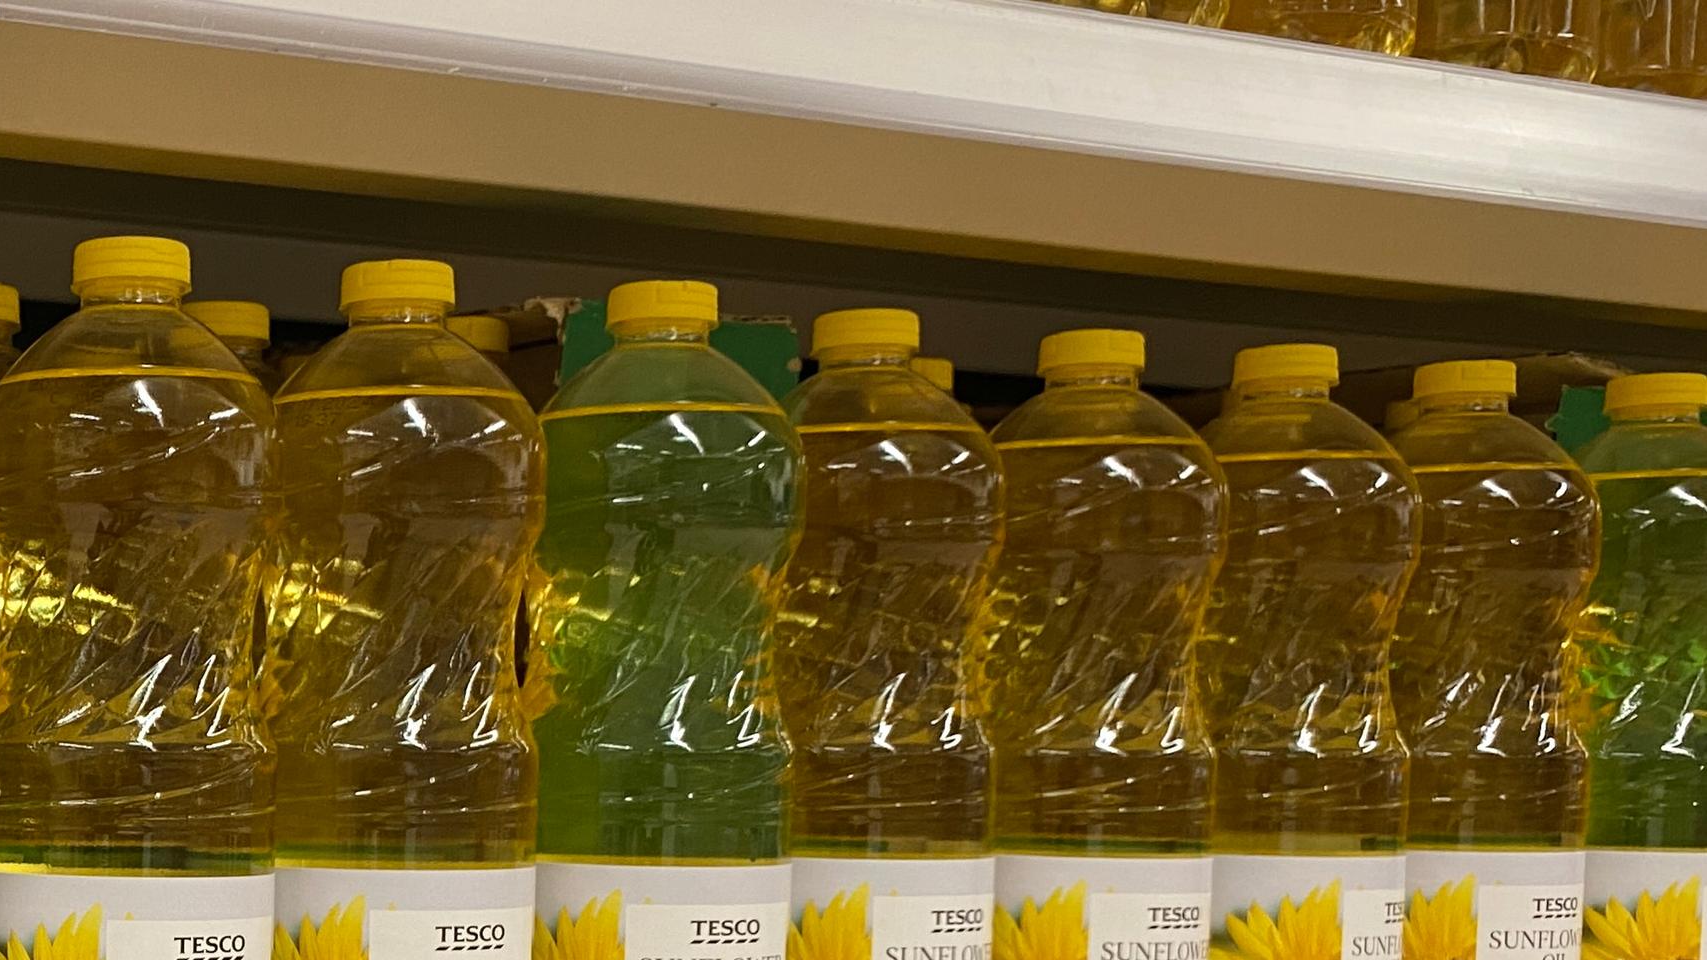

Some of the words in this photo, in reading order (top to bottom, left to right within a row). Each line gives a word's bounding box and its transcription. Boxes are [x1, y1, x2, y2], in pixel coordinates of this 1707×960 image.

[1385, 902, 1403, 916] TES
[1533, 897, 1577, 912] TESCO
[931, 909, 983, 926] TESCO
[1148, 907, 1200, 922] TESCO
[435, 924, 505, 943] TESCO
[691, 919, 760, 937] TESCO
[174, 935, 245, 954] TESCO
[1352, 935, 1402, 956] SUNFL
[1489, 929, 1582, 950] SUNFLOW
